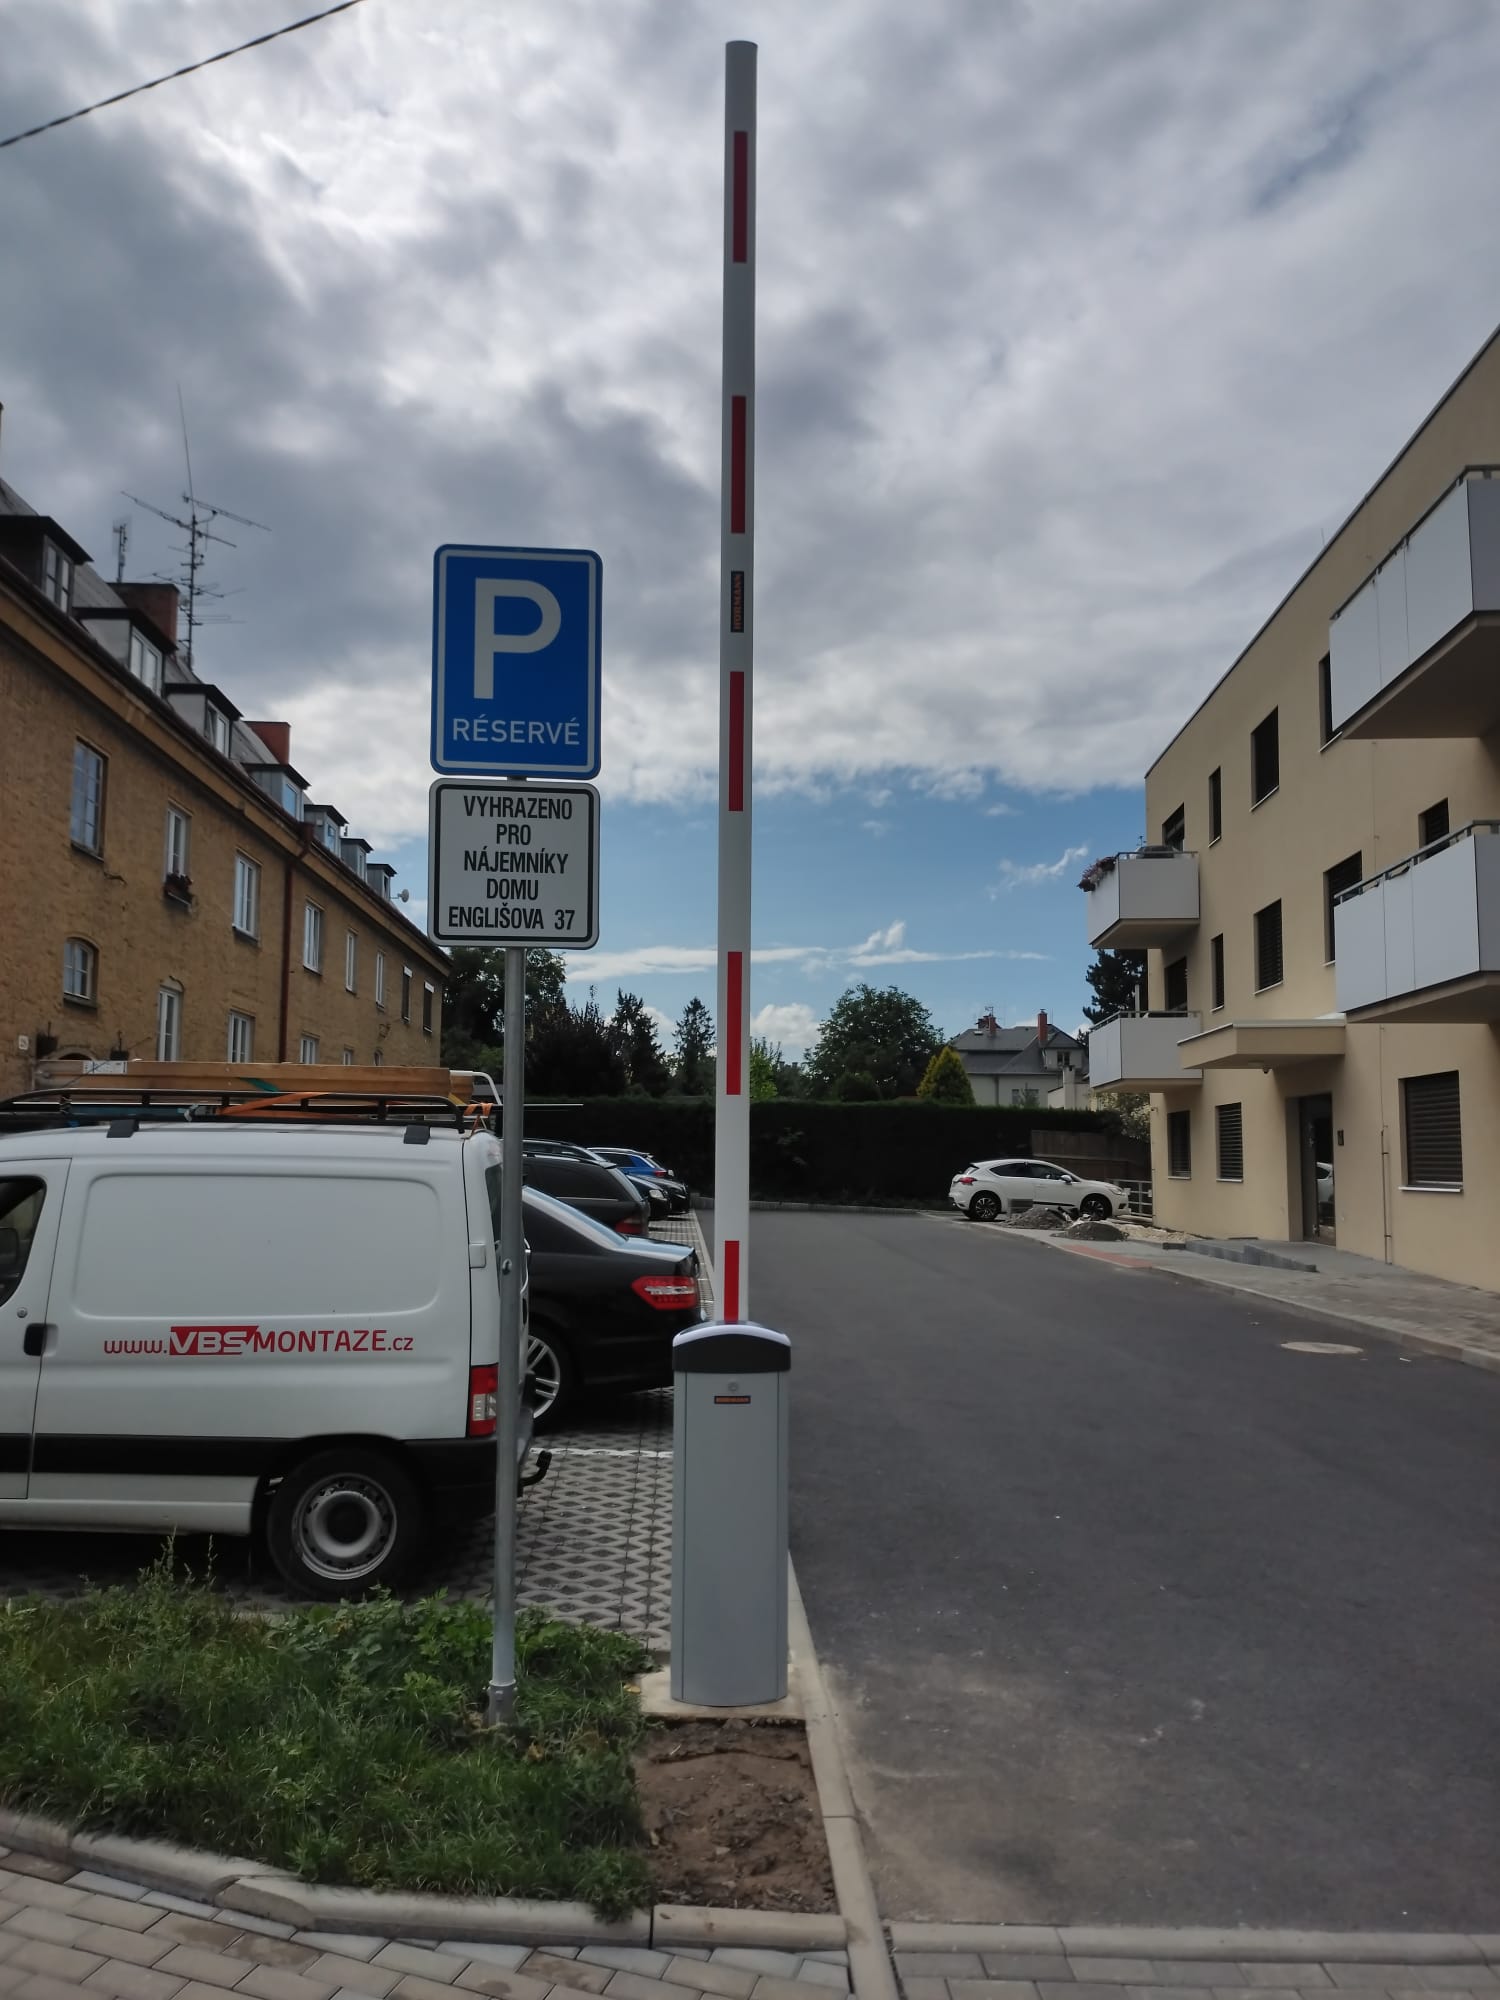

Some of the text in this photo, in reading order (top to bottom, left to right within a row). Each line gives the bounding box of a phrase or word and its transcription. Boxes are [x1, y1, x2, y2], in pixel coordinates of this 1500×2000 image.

[473, 577, 562, 700] P
[452, 714, 581, 746] RÉSERVÉ
[463, 795, 573, 820] VYHRAZENO
[495, 824, 531, 846] PRO
[463, 849, 569, 875] NÁJEMNÍKY
[485, 878, 539, 901] DOMU
[448, 902, 576, 931] ENGLIŠOVA 37
